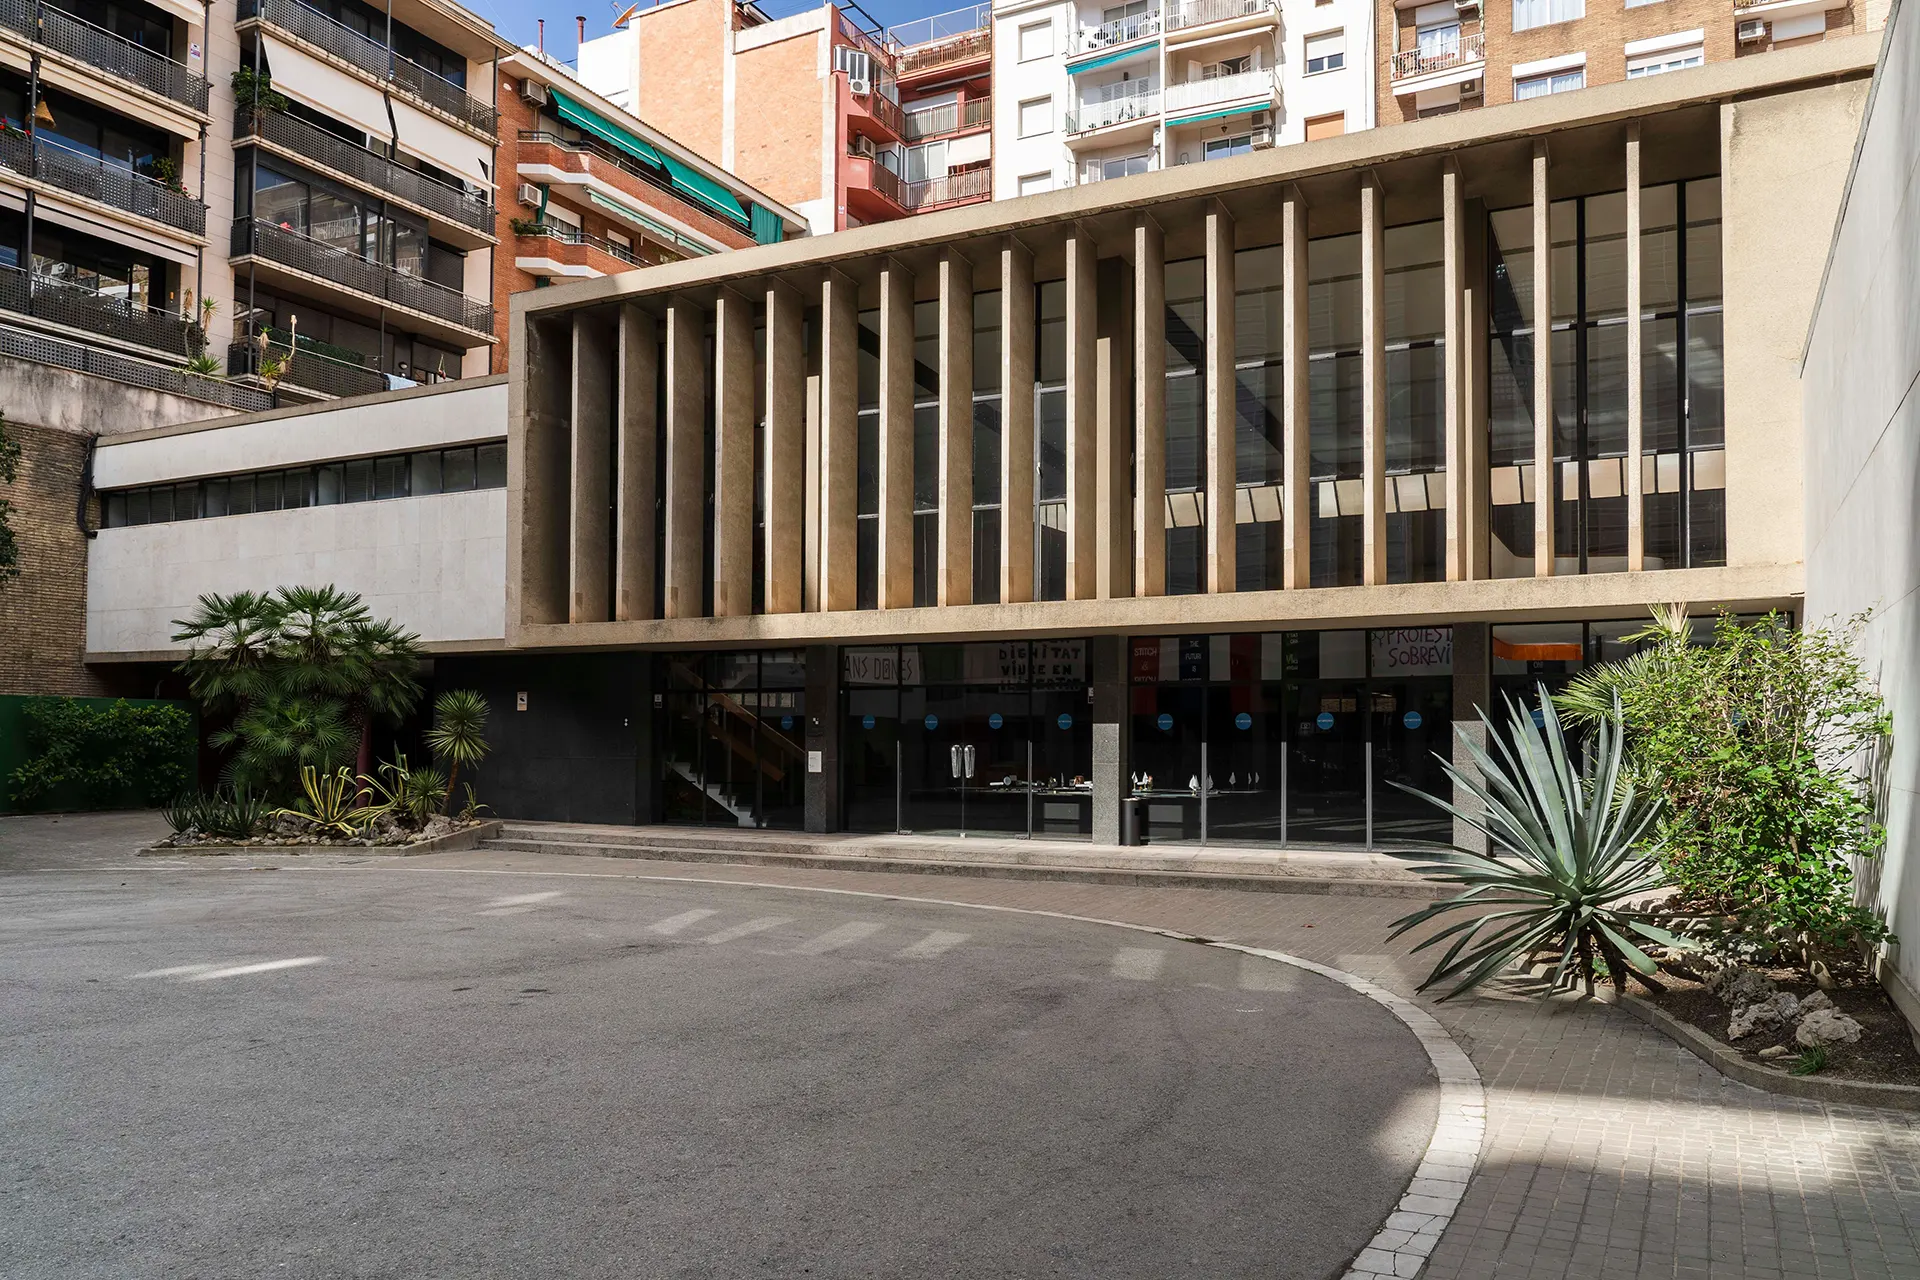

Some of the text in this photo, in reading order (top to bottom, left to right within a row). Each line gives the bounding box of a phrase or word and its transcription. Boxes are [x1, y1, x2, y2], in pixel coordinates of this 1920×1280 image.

[1387, 628, 1453, 645] PROTEST
[1134, 646, 1158, 657] STITCH
[1053, 664, 1073, 675] EN
